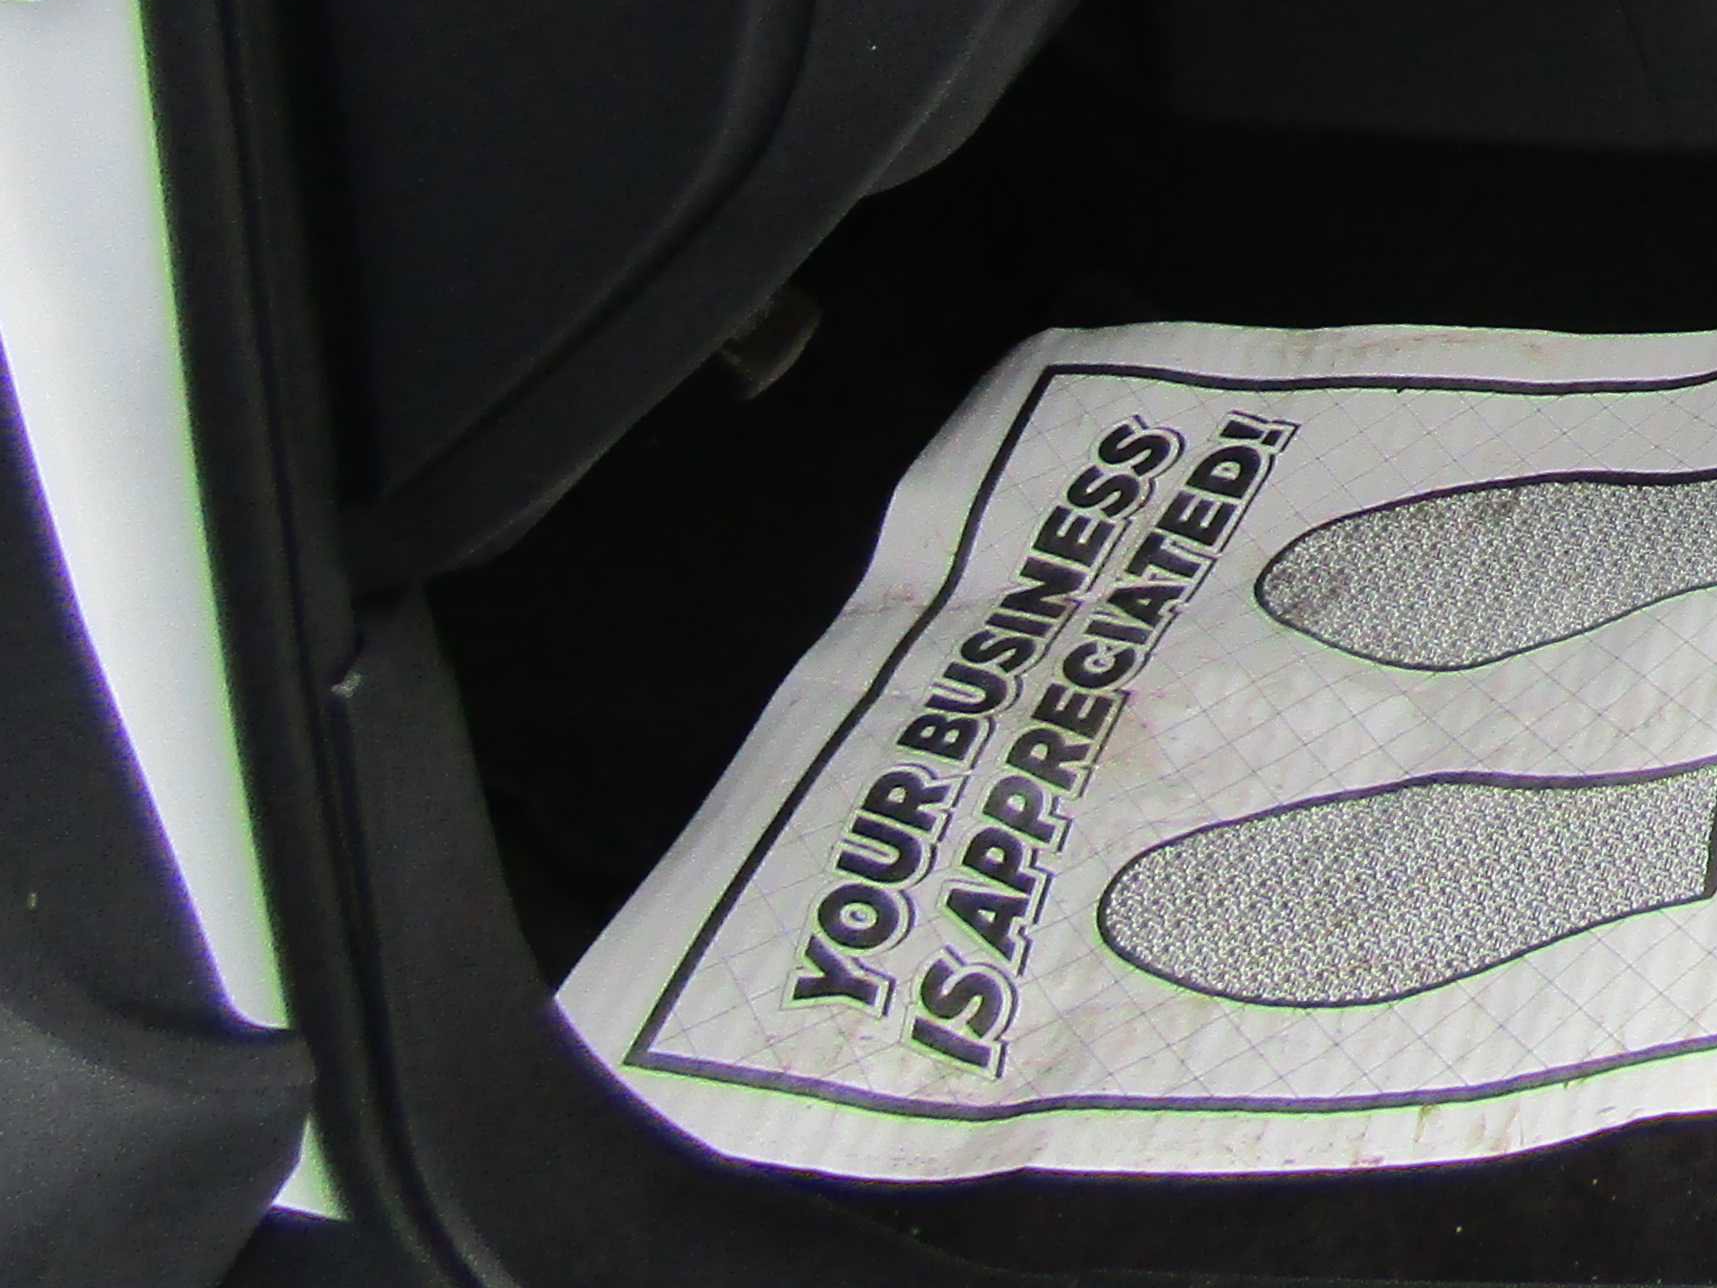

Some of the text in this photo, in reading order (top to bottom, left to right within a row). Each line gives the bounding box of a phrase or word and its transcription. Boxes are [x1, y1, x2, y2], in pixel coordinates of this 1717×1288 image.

[785, 415, 1187, 1017] YOUR BUSINESS
[901, 409, 1302, 1079] IS APPRECIATED!
